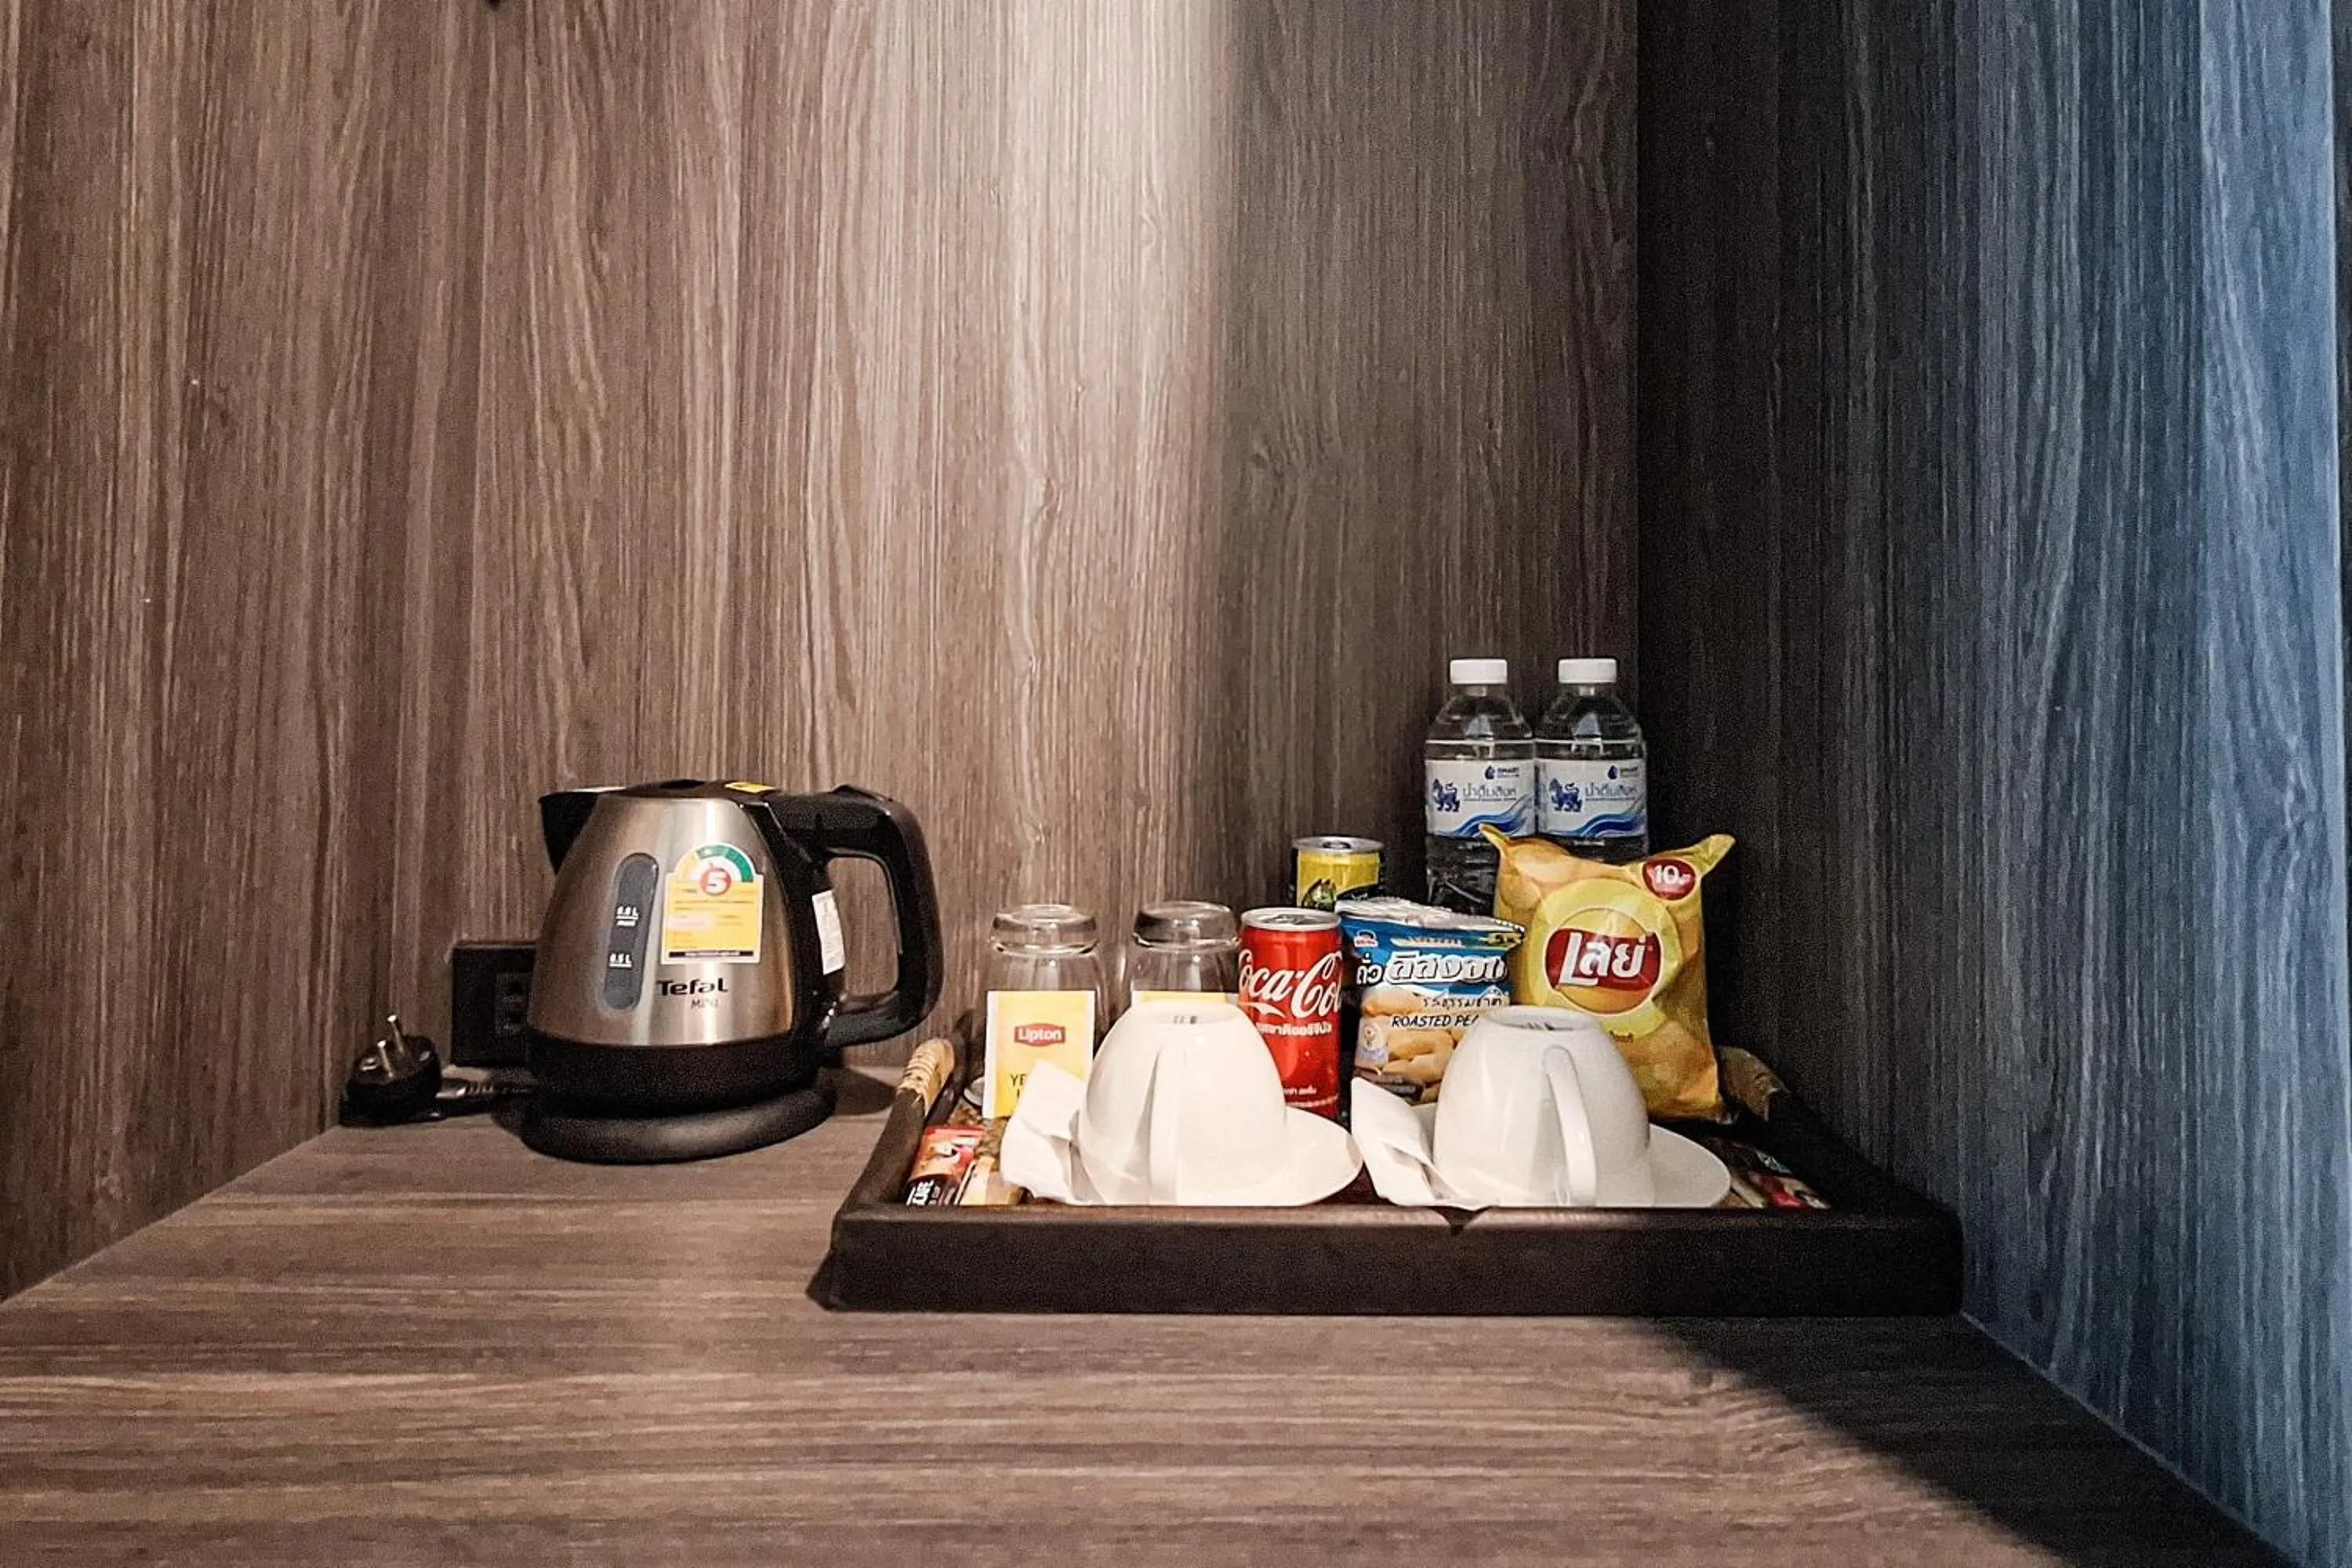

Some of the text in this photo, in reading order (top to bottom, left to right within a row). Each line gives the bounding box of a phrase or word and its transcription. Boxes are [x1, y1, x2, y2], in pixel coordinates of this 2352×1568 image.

[655, 978, 728, 996] Tefal
[1239, 948, 1342, 1018] Coca-Col
[1392, 1014, 1450, 1028] ROASTED
[1018, 1027, 1062, 1044] Lipton
